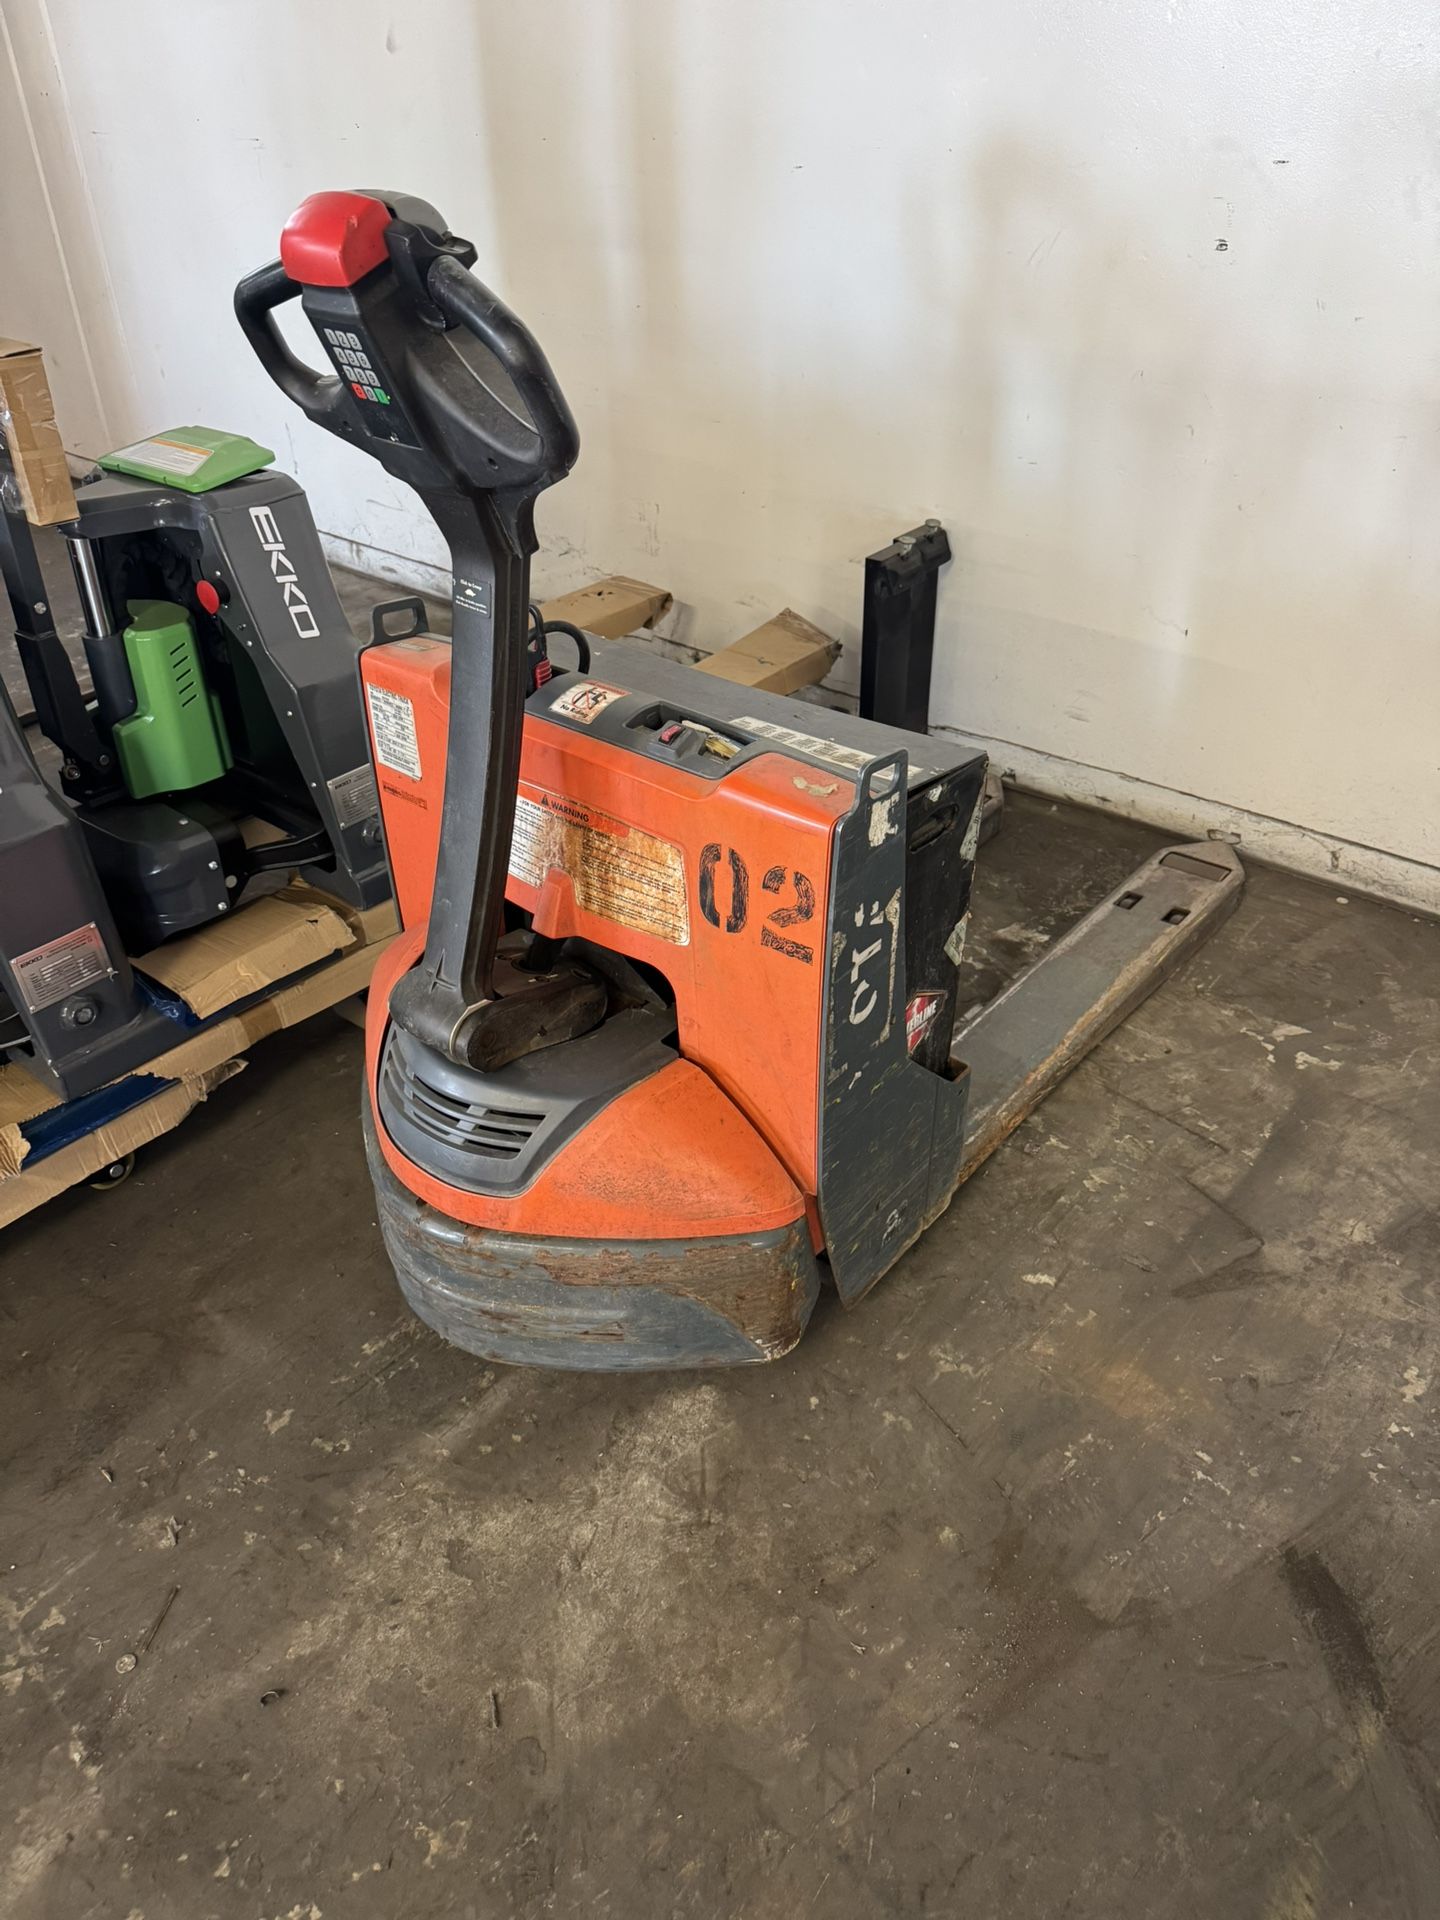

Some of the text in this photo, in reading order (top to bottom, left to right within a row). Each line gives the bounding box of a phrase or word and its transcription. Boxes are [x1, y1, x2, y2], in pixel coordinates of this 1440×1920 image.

[249, 506, 320, 639] EKKO
[551, 801, 589, 823] WARNING
[699, 842, 816, 967] 02
